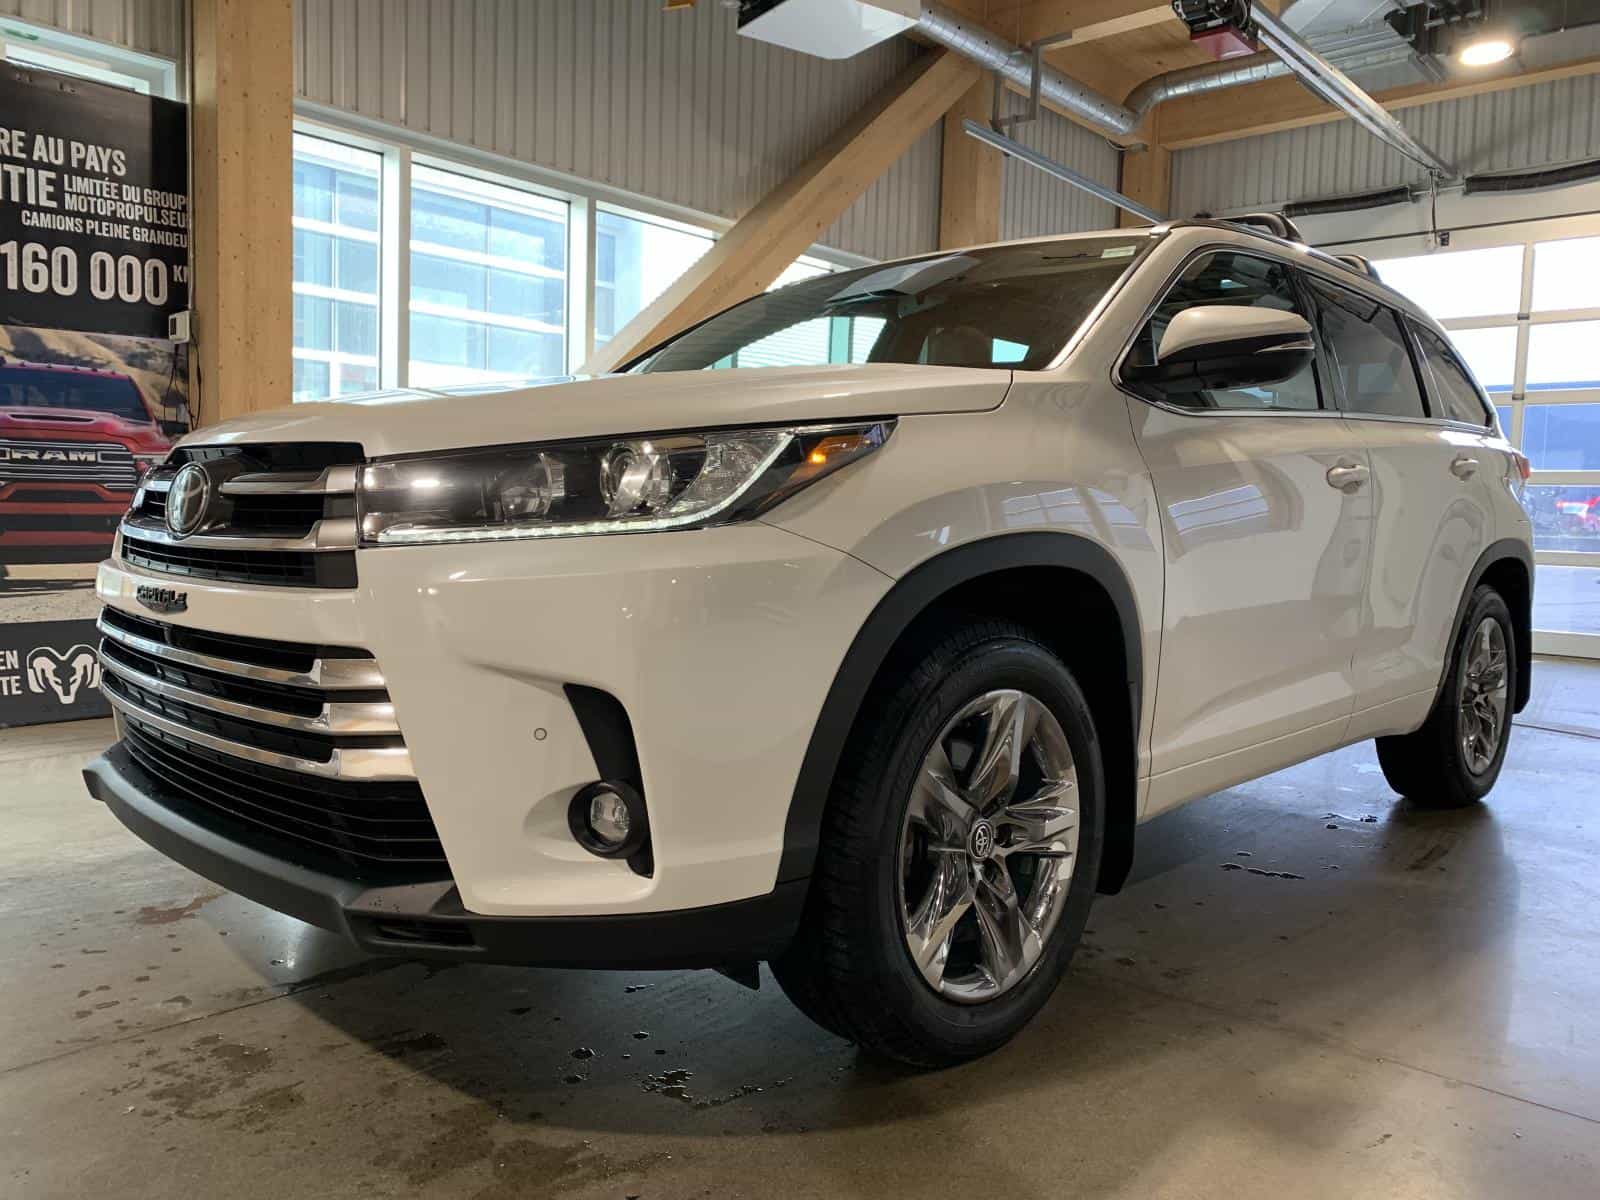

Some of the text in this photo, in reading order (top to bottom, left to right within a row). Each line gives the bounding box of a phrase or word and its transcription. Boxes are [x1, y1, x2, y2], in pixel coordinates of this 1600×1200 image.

[33, 134, 64, 165] AU
[71, 141, 127, 176] PAYS
[0, 163, 57, 208] TIE
[64, 173, 188, 211] LIMITÉE DU GROUP
[22, 210, 83, 233] CAMIONS
[86, 219, 131, 241] PLEINE
[64, 192, 187, 228] MOTOPROPULSEU
[0, 240, 78, 296] 160
[90, 251, 168, 306] 000
[11, 449, 97, 462] RAM
